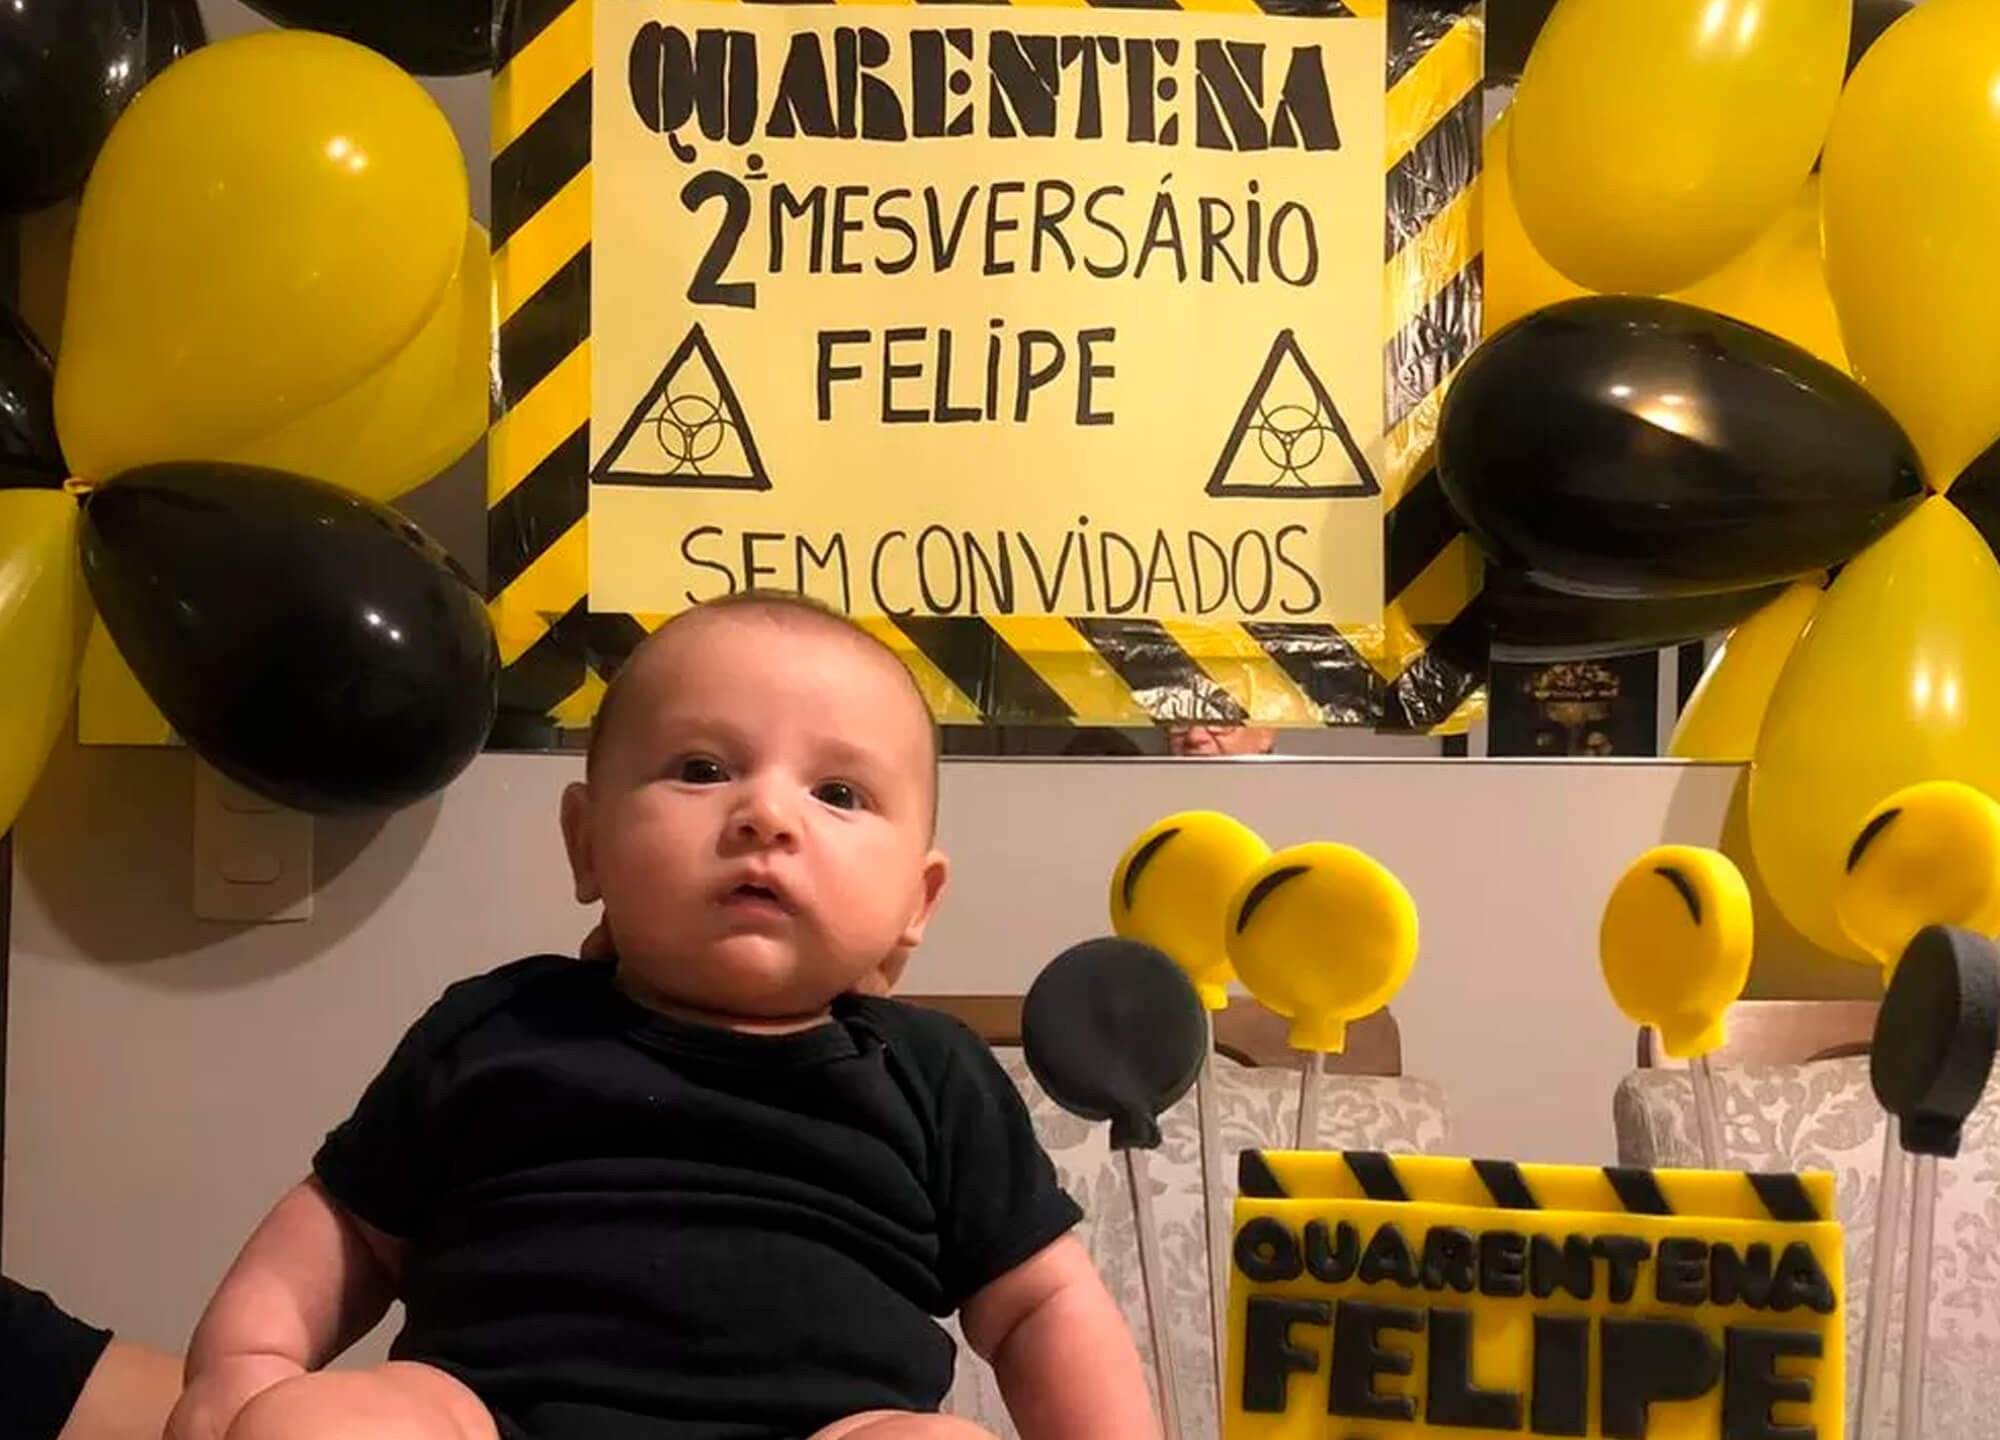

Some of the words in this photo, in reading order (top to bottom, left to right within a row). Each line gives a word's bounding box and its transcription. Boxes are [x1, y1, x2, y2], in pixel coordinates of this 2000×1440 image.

[628, 21, 1342, 163] QUARENTENA
[769, 173, 1319, 286] MESVERSÁRIO
[816, 318, 1117, 426] FELIPE
[681, 526, 850, 614] SEM
[871, 515, 1322, 615] CONVIDADOS
[1233, 1216, 1837, 1315] QUARENTENA
[1241, 1296, 1824, 1440] FELIPE
